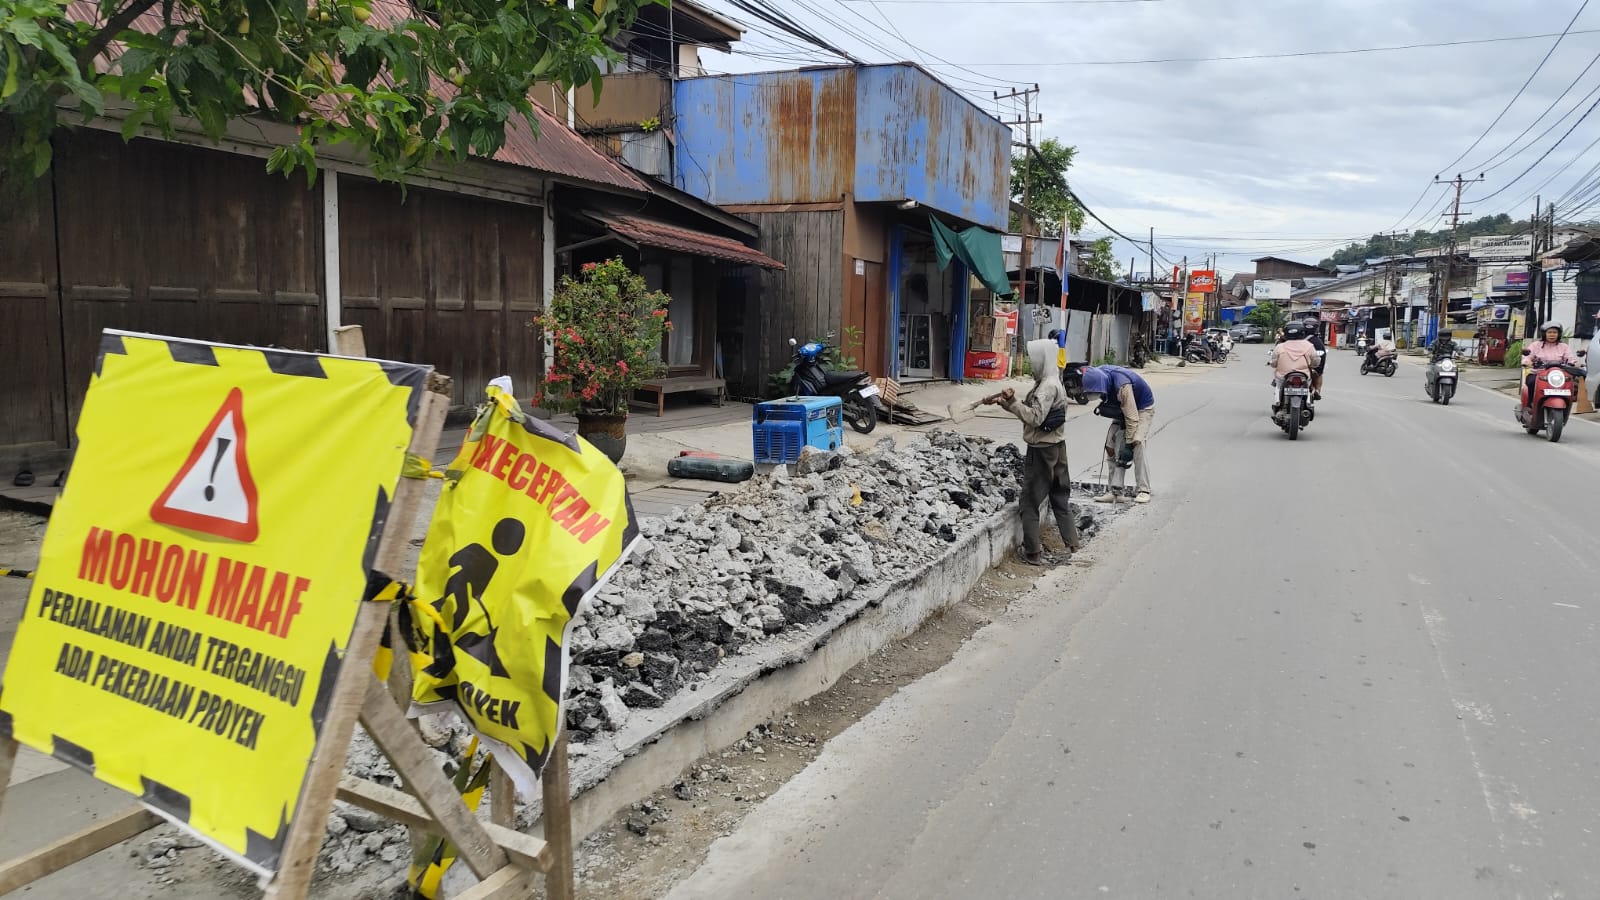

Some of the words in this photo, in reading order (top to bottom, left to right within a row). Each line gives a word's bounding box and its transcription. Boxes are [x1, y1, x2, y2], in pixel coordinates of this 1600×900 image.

[78, 525, 209, 611] MOHON
[206, 556, 311, 640] MAAF
[38, 587, 152, 650] PERJALANAN
[147, 620, 203, 668] ANDA
[201, 635, 307, 708] TERGANGGU
[54, 642, 94, 684] ADA
[91, 653, 197, 720] PEKERJAAN
[187, 689, 266, 751] PROYEK
[460, 680, 521, 731] OYEK
